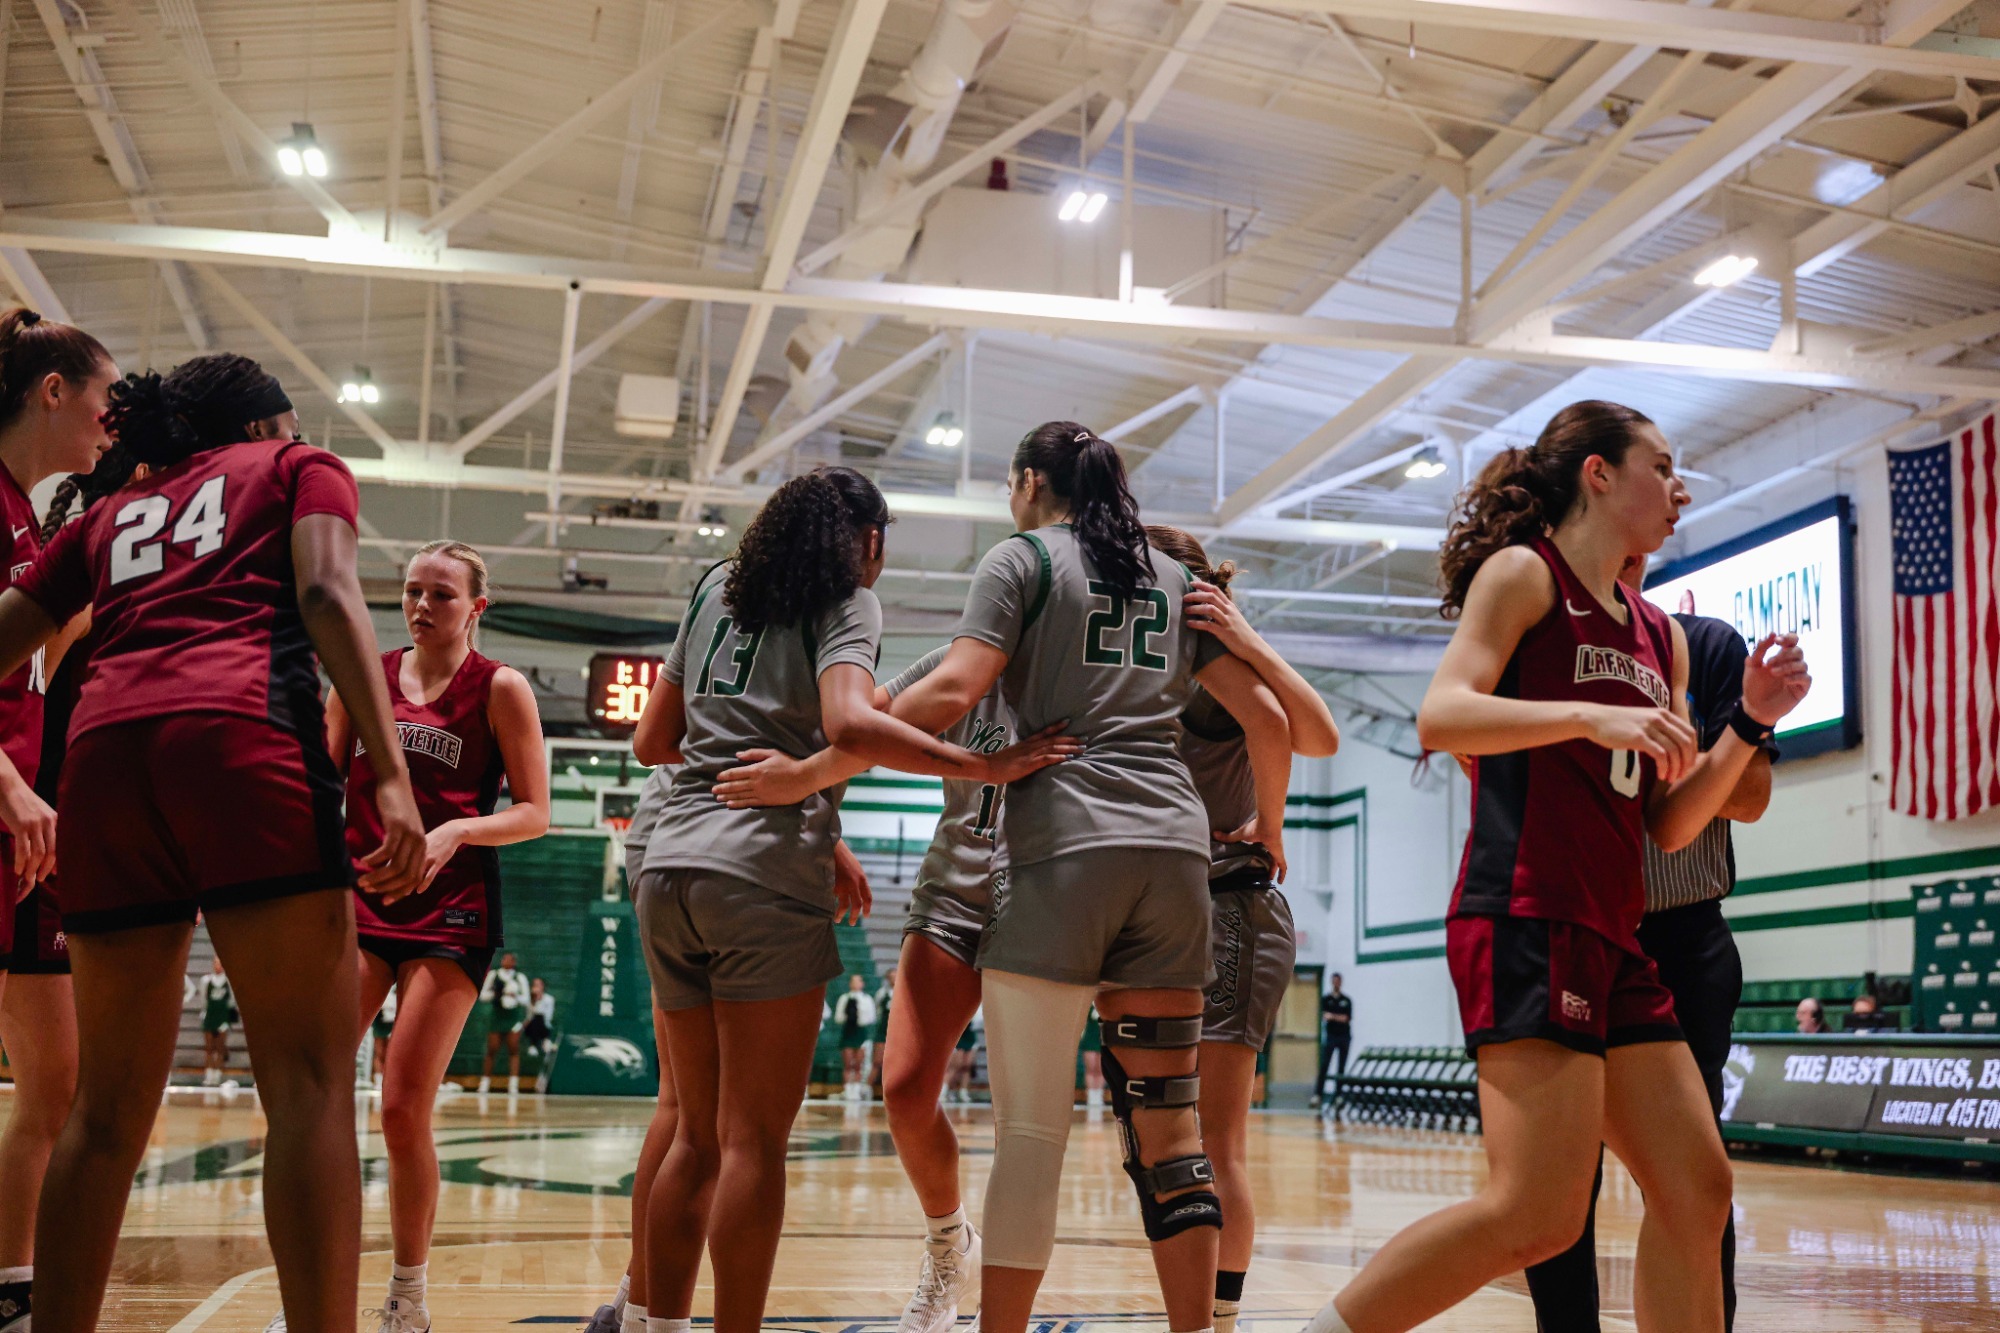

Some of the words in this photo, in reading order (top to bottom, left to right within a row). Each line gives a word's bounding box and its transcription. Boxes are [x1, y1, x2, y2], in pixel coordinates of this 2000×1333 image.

[110, 474, 227, 586] 24
[1083, 579, 1170, 672] 22
[1735, 562, 1822, 650] GAMEDAY
[694, 616, 767, 697] 13
[1574, 645, 1670, 710] LAFAYETTE
[606, 684, 649, 721] 30
[973, 783, 1007, 841] 1
[600, 917, 620, 1017] WAGNER
[1210, 907, 1242, 1013] Seahawks
[1784, 1055, 1828, 1083] THE
[1825, 1056, 1890, 1085] BEST
[1889, 1057, 1975, 1092] WINGS,
[1977, 1058, 2000, 1090] B
[1881, 1100, 1933, 1126] LOCATED
[1928, 1102, 1949, 1127] AT
[1946, 1097, 1979, 1129] 415
